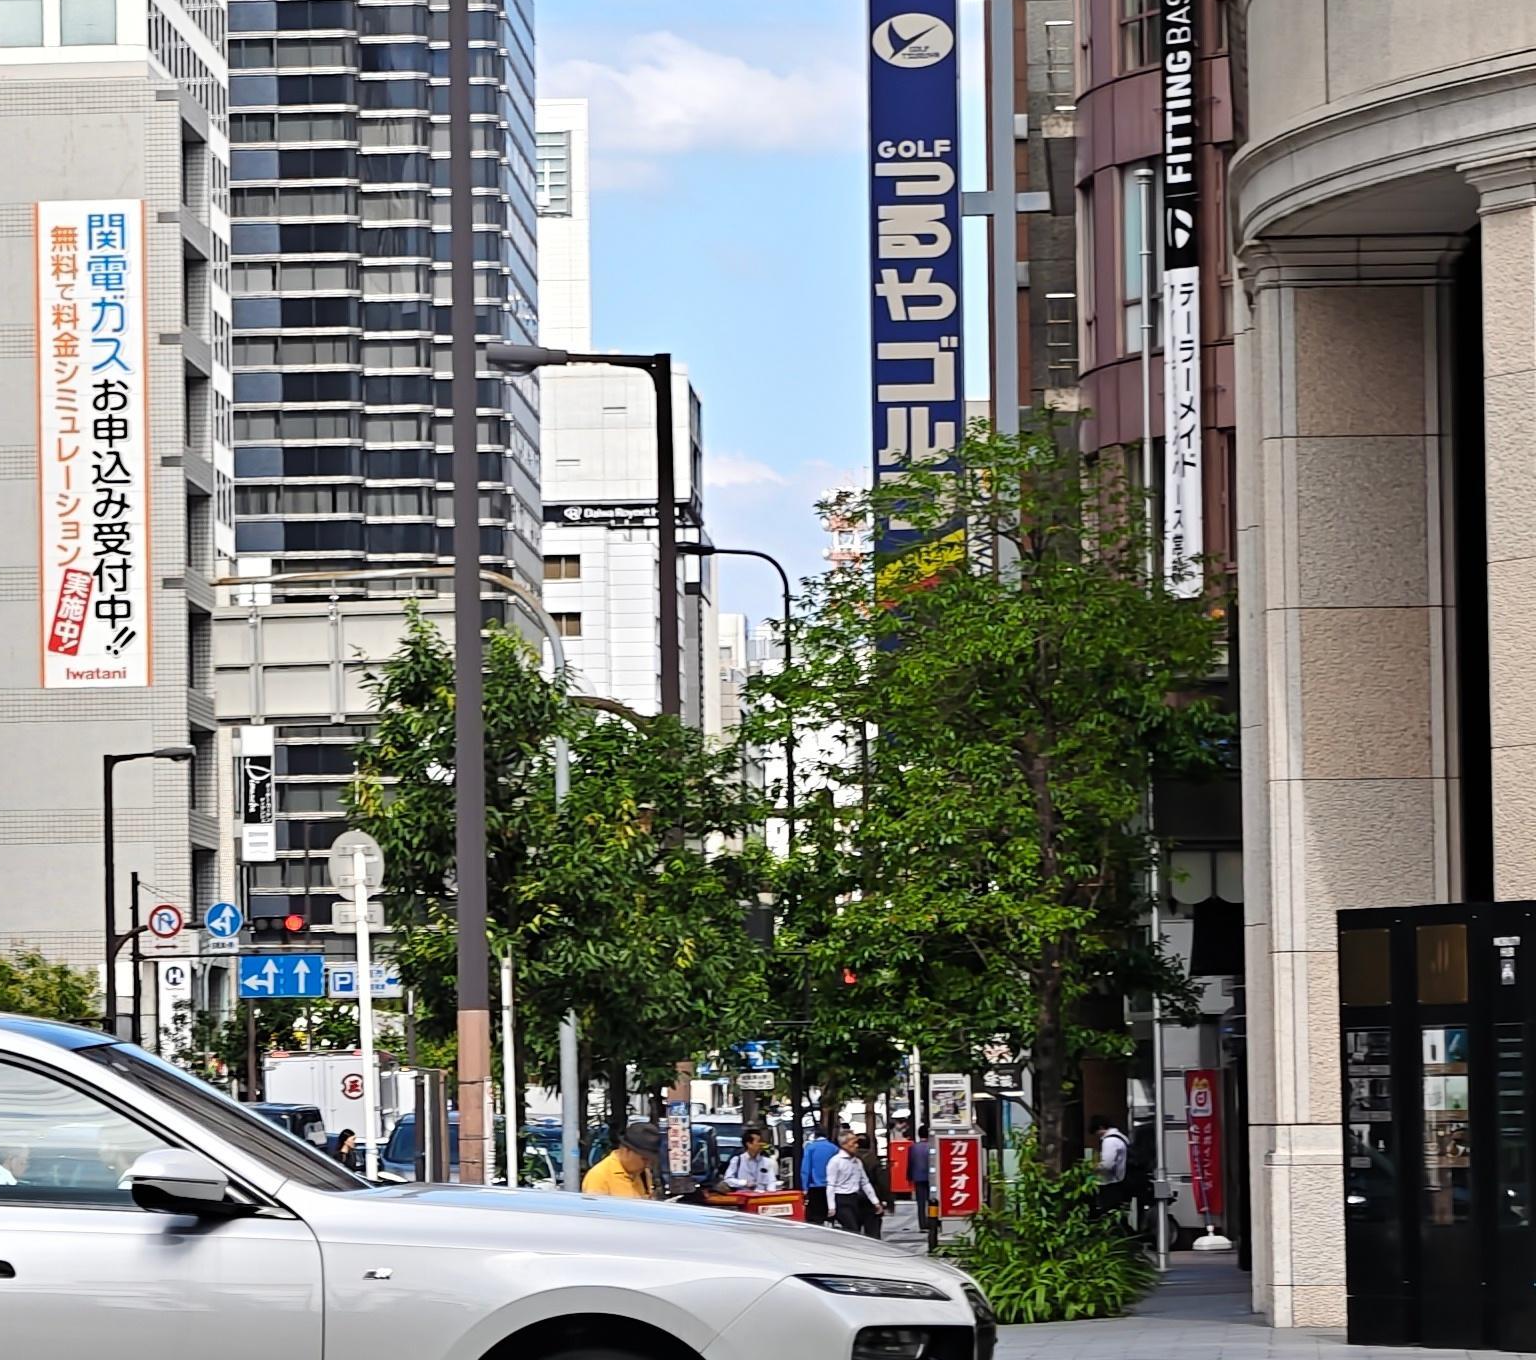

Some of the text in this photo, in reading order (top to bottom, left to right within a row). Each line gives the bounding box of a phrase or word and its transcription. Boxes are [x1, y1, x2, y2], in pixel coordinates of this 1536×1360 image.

[877, 140, 951, 158] GOLF
[50, 225, 81, 567] 無料で料金シミュレーション
[1178, 283, 1197, 478] テーラーメイド
[66, 667, 127, 679] Iwatani
[950, 1141, 970, 1207] カラオケ
